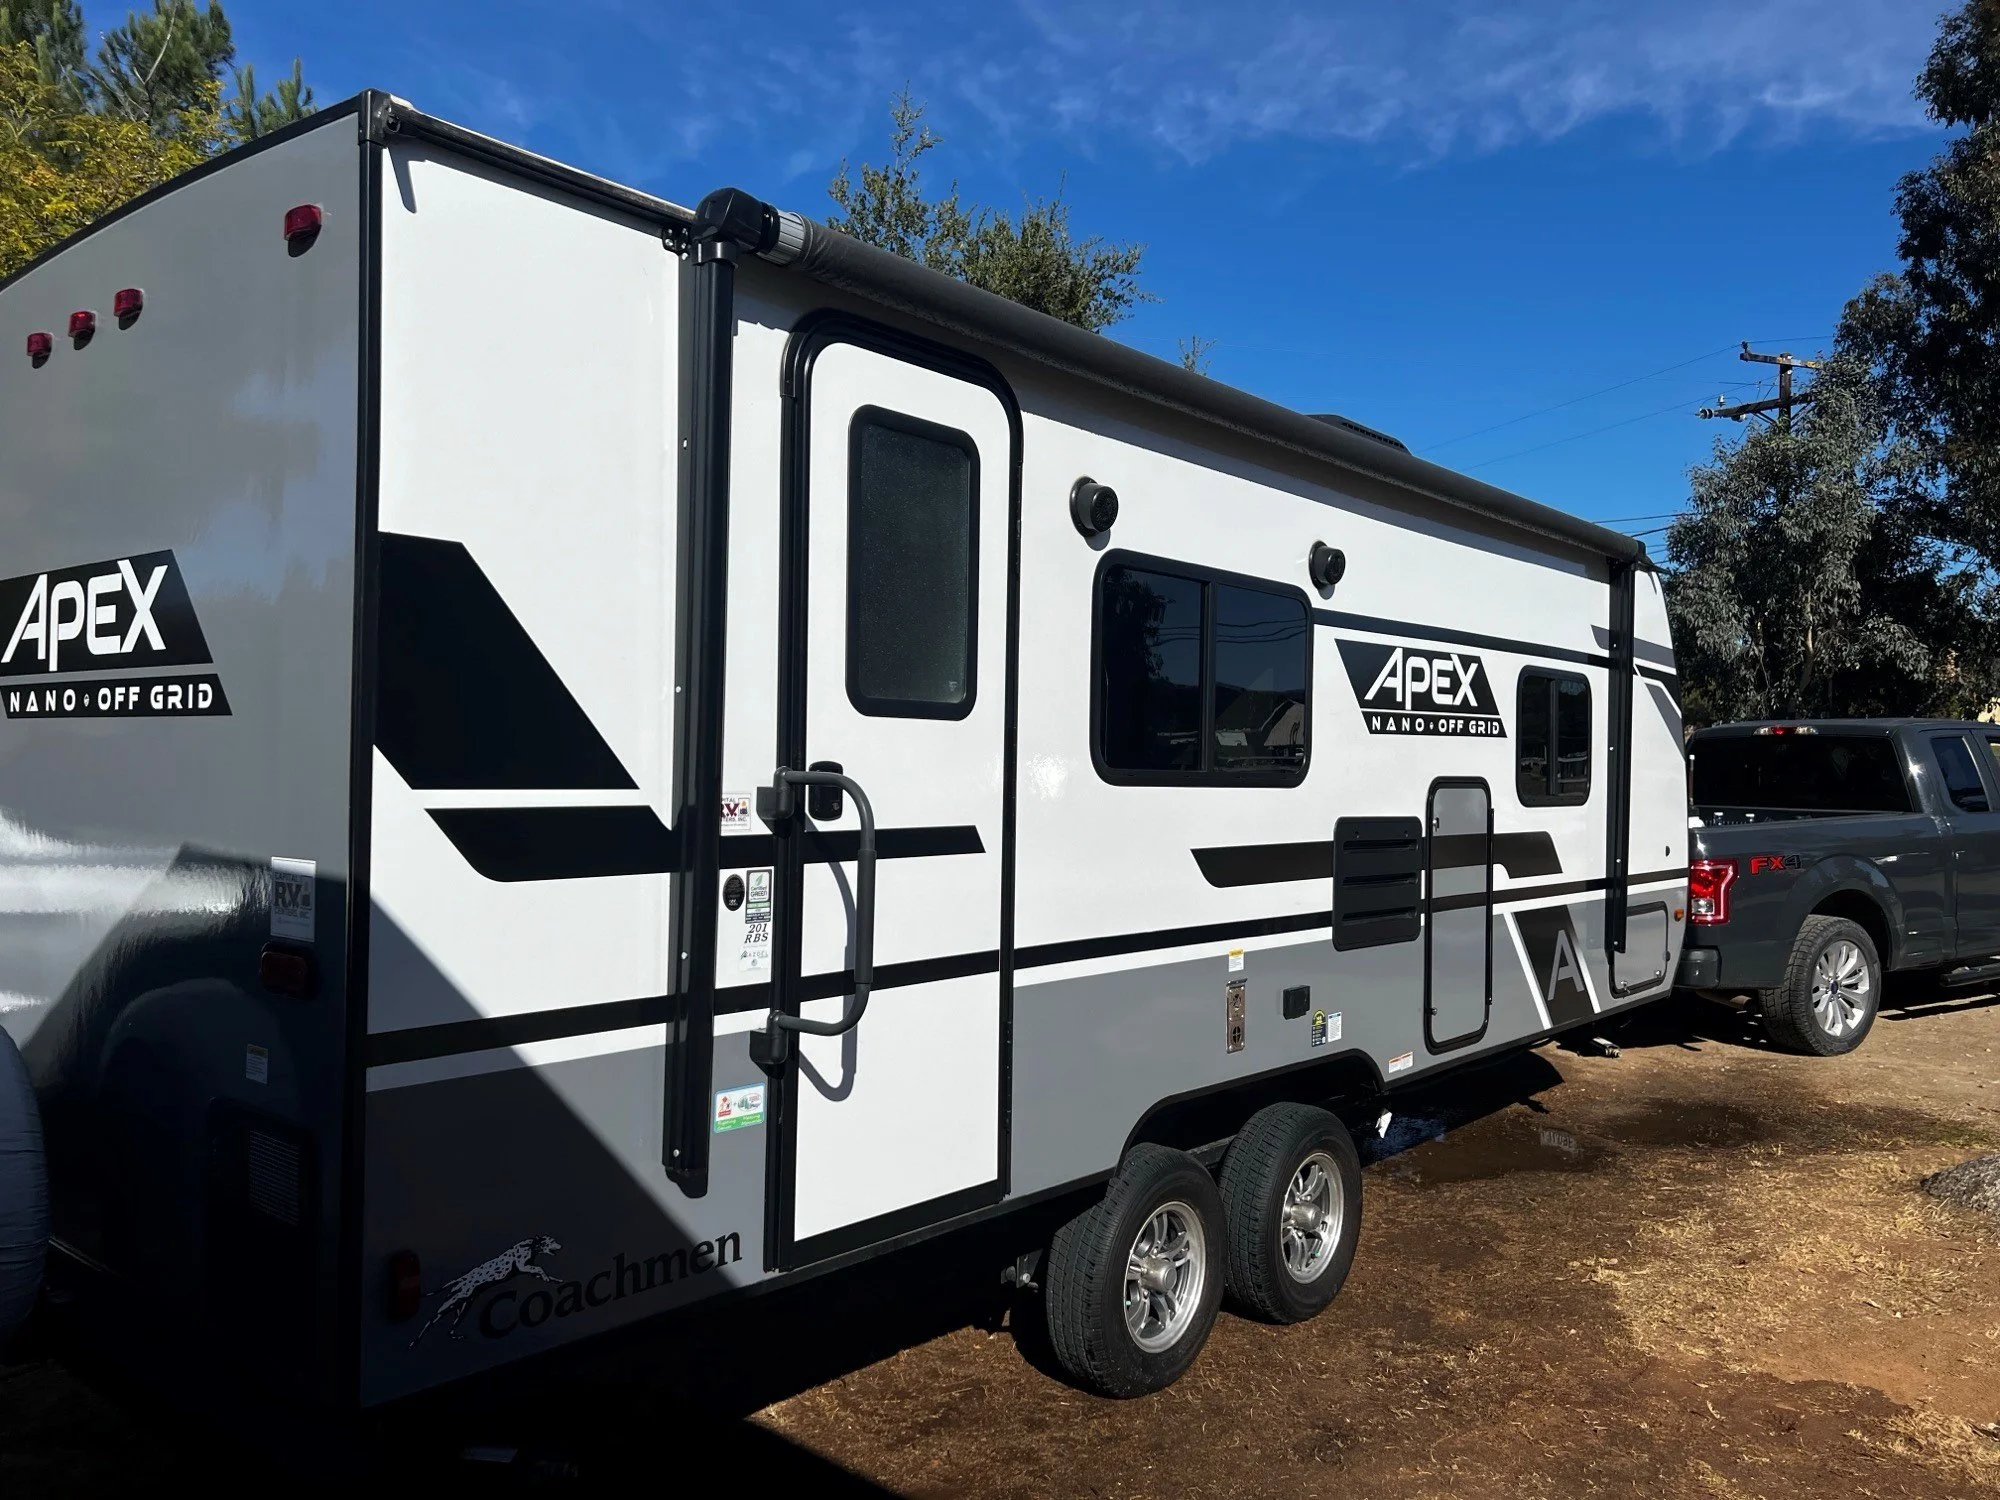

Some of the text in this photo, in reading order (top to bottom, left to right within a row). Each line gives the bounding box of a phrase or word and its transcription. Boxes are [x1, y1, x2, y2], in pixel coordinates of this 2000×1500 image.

[1, 559, 169, 672] APEX
[1364, 648, 1479, 711] APEX
[9, 683, 213, 713] NANO OFF GRID
[1371, 715, 1500, 734] NANO OFF GRID
[1750, 855, 1802, 875] FX4
[744, 932, 769, 944] RBS
[748, 923, 768, 934] 201
[1548, 930, 1585, 1001] A
[478, 1229, 743, 1339] Coachmen
